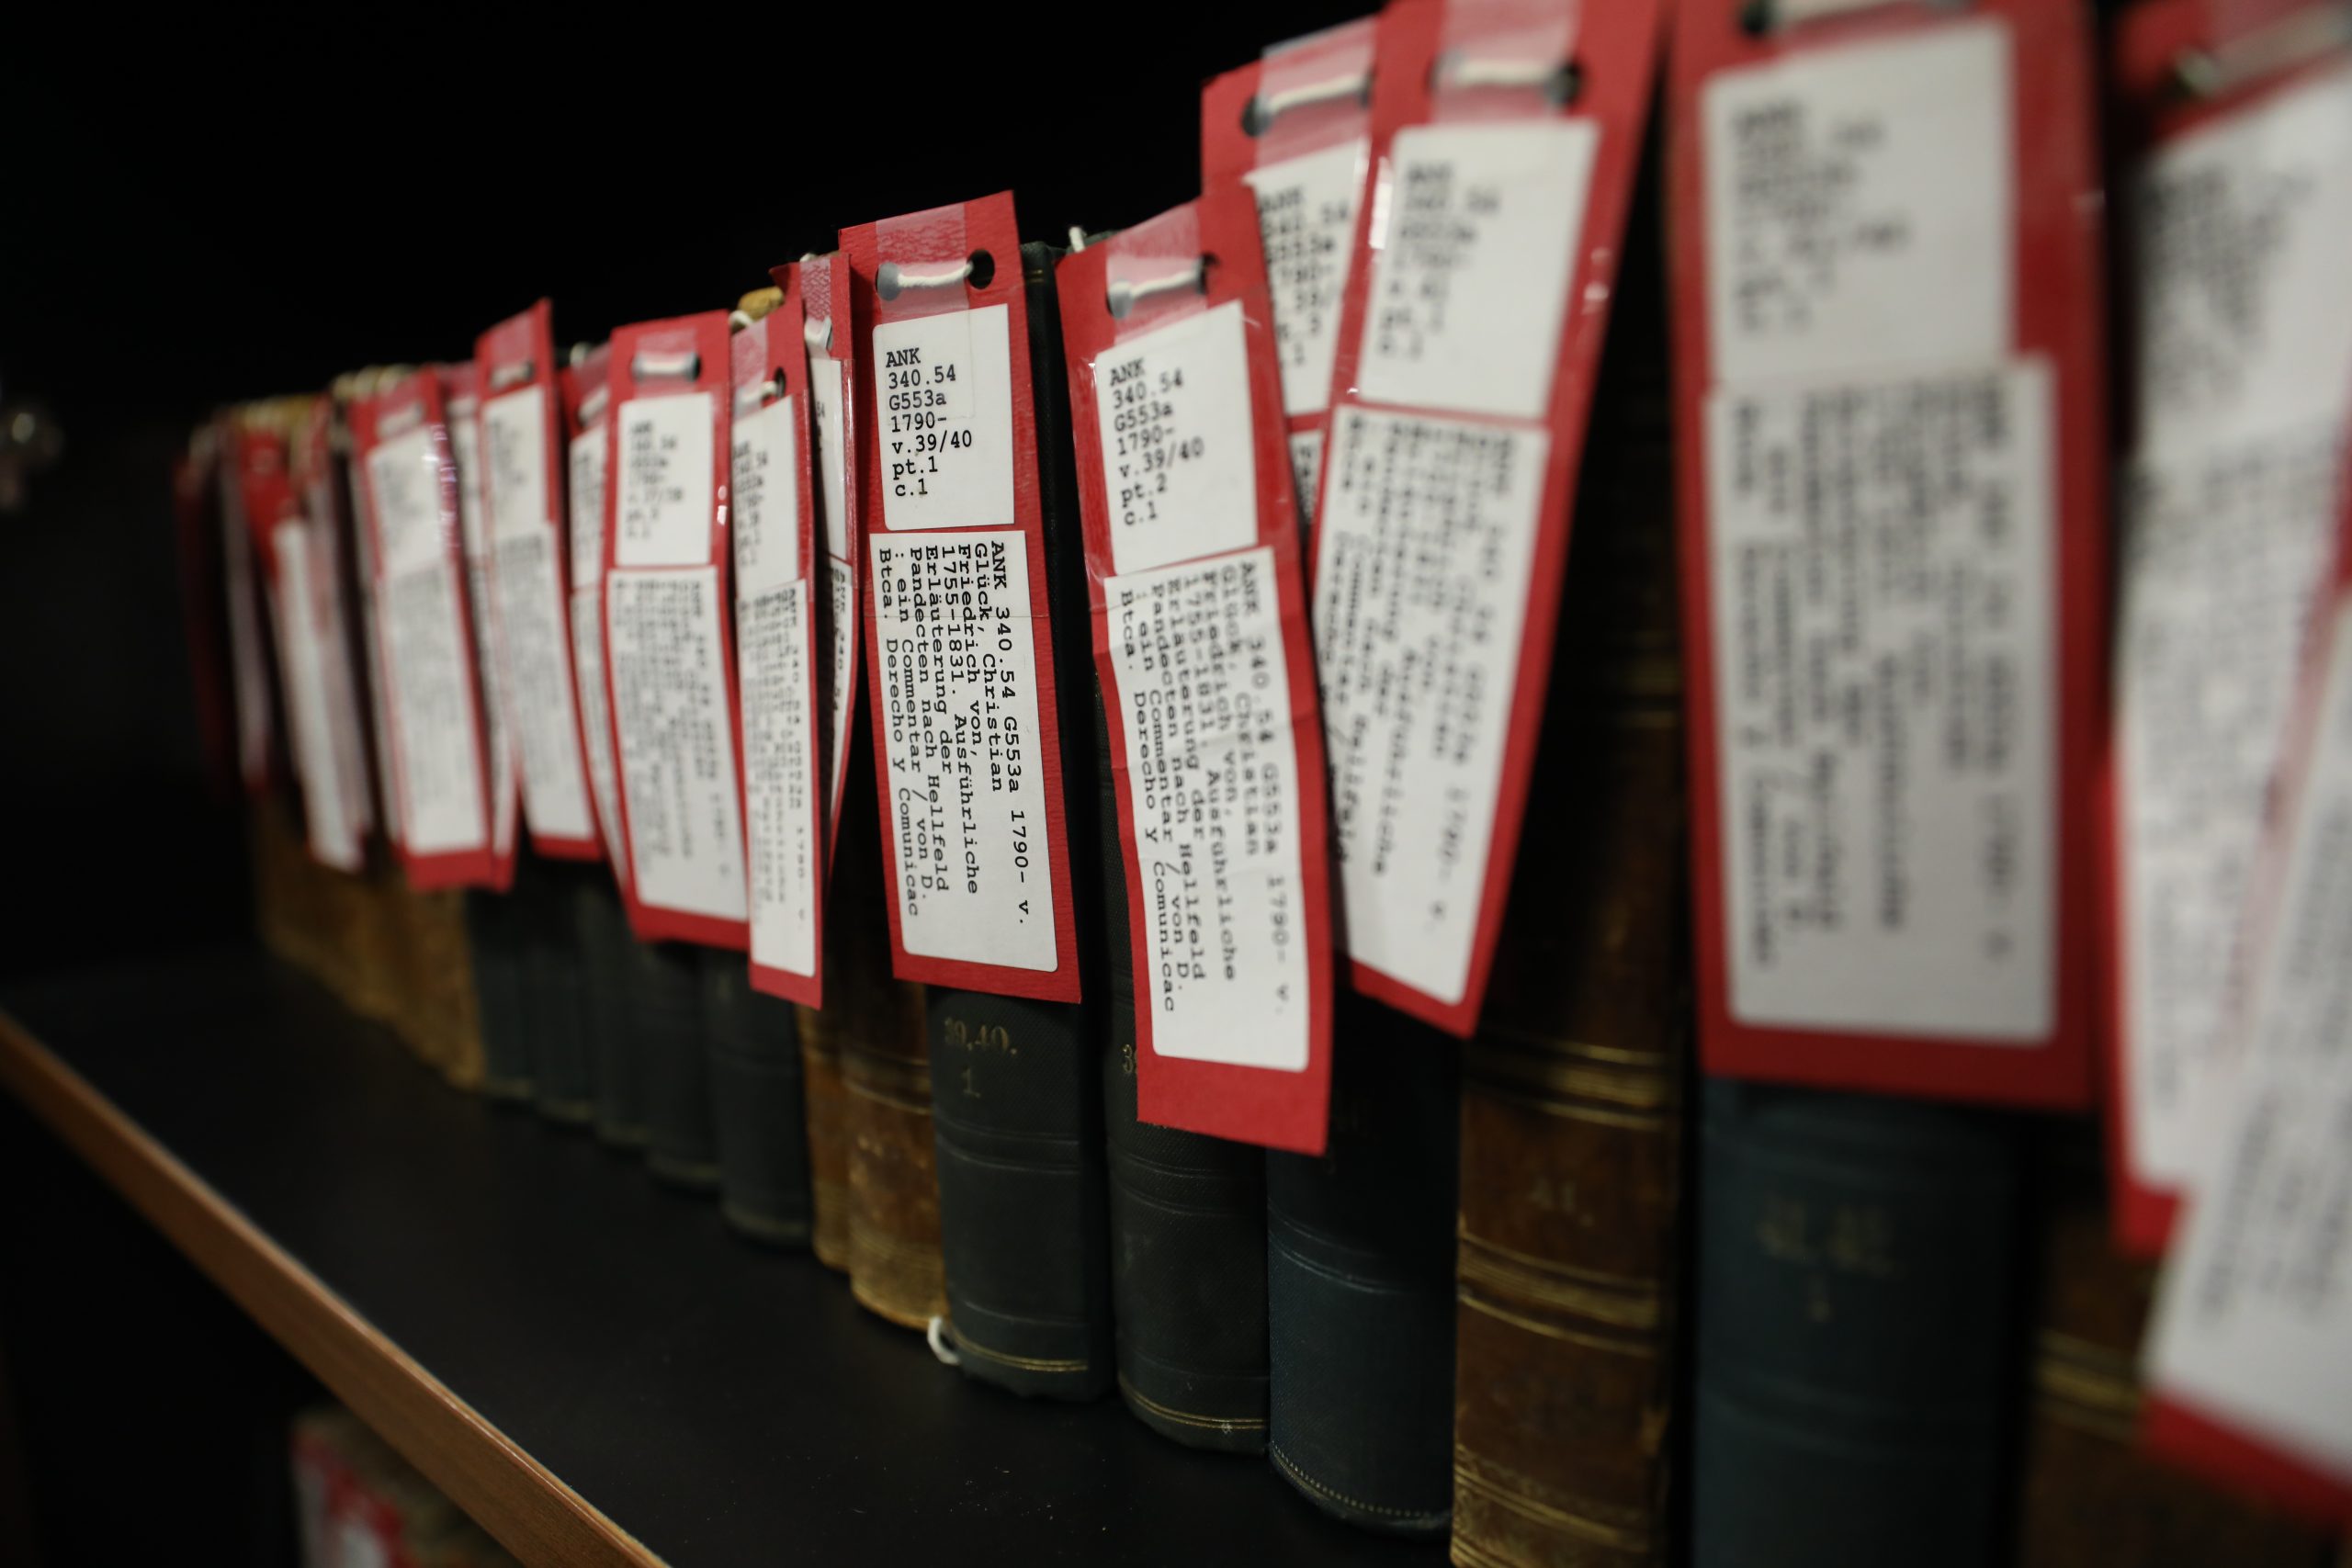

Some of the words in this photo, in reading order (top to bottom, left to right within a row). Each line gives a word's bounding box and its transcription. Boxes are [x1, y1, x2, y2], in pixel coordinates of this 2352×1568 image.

[886, 347, 921, 367] ANK
[888, 365, 956, 389] 340.54
[1110, 357, 1145, 387] ANK
[888, 389, 946, 412] G553a
[1113, 367, 1184, 409] 340.54
[890, 412, 947, 433] 1790-
[892, 430, 972, 454] v.39/40
[1114, 400, 1173, 433] G553a
[1117, 423, 1175, 457] 1790-
[892, 456, 938, 480] pt.1
[1119, 435, 1204, 479] v.39/40
[895, 478, 928, 497] c.1
[1121, 472, 1168, 508] pt.2
[1124, 501, 1158, 525] c.1
[879, 548, 892, 618] Btca.
[975, 543, 992, 632] Glück,
[991, 540, 1007, 590] ANK
[897, 579, 910, 623] ein
[910, 547, 929, 682] Pandecten
[925, 546, 947, 715] Erläuterung
[940, 730, 953, 773] der
[958, 544, 980, 683] Friedrich
[970, 700, 982, 755] von,
[996, 607, 1016, 698] 340.54
[1152, 583, 1179, 738] Pandecten
[887, 639, 904, 742] Derecho
[902, 639, 921, 772] Commentar
[922, 700, 937, 758] nach
[942, 547, 964, 694] 1755-1831.
[955, 714, 979, 894] Ausführliche
[983, 653, 1003, 792] Christian
[892, 758, 906, 773] y
[1004, 716, 1022, 793] G553a
[1120, 590, 1136, 670] Btca.
[1134, 692, 1156, 809] Derecho
[1146, 828, 1159, 843] y
[1153, 861, 1174, 1011] Comunicac
[1138, 621, 1155, 671] ein
[1148, 689, 1172, 842] Commentar
[1171, 896, 1183, 944] von
[1177, 963, 1189, 990] D.
[1170, 756, 1190, 824] nach
[899, 787, 918, 916] Comunicac
[916, 818, 928, 859] von
[928, 775, 949, 891] Hellfeld
[1011, 810, 1029, 883] 1790-
[921, 875, 933, 898] D.
[1019, 899, 1029, 923] v.
[1179, 843, 1206, 980] Hellfeld
